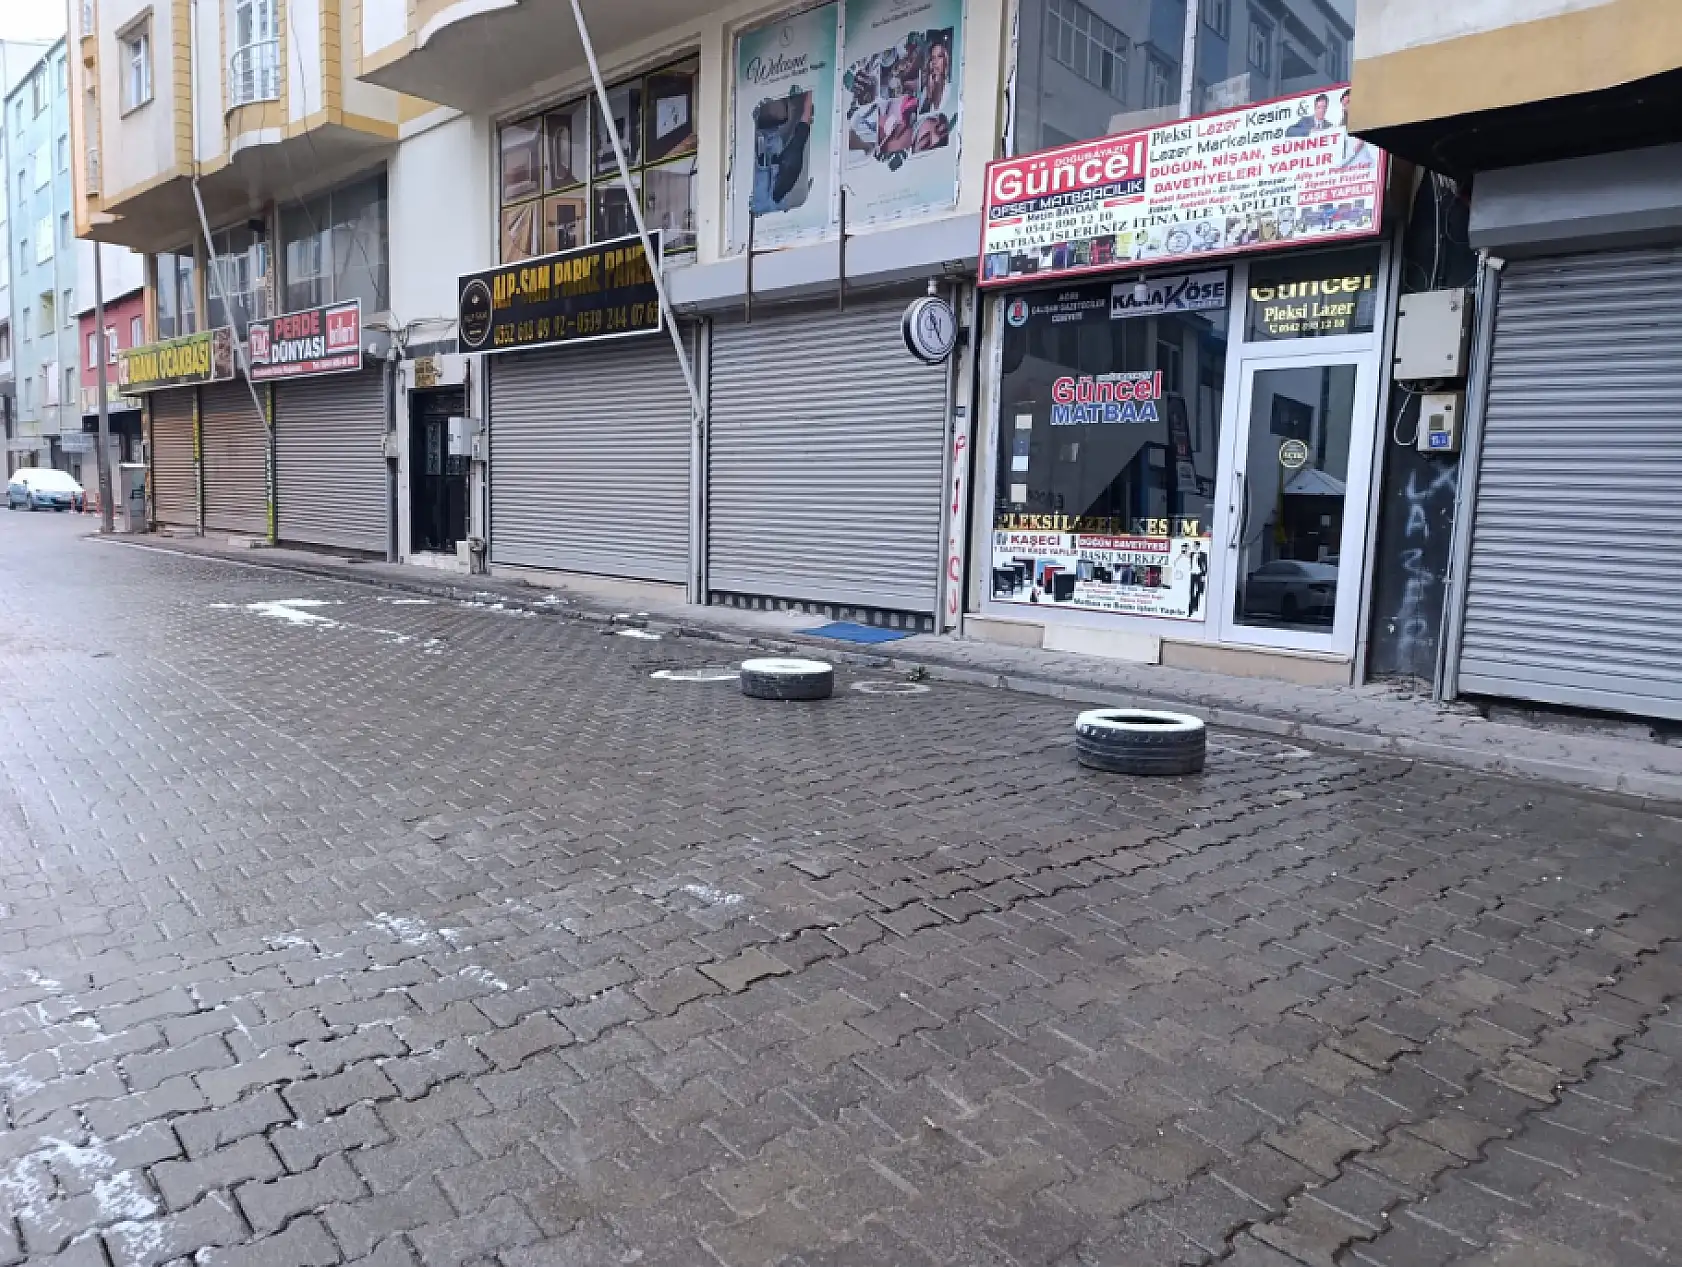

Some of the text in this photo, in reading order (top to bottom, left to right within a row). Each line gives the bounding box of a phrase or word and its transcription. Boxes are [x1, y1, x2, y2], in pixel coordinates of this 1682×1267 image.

[1152, 126, 1192, 147] Pleksi
[1198, 118, 1241, 138] Lazer
[1246, 107, 1292, 128] Kesim
[1150, 128, 1284, 163] Lazer Markalama
[1271, 133, 1341, 156] SÜNNET
[994, 141, 1143, 200] Güncel
[1268, 152, 1333, 175] YAPILIR
[275, 311, 321, 341] PERDE
[1264, 302, 1356, 322] Pleksi Lazer
[1051, 369, 1163, 404] Güncel
[1050, 401, 1160, 426] MATBAA
